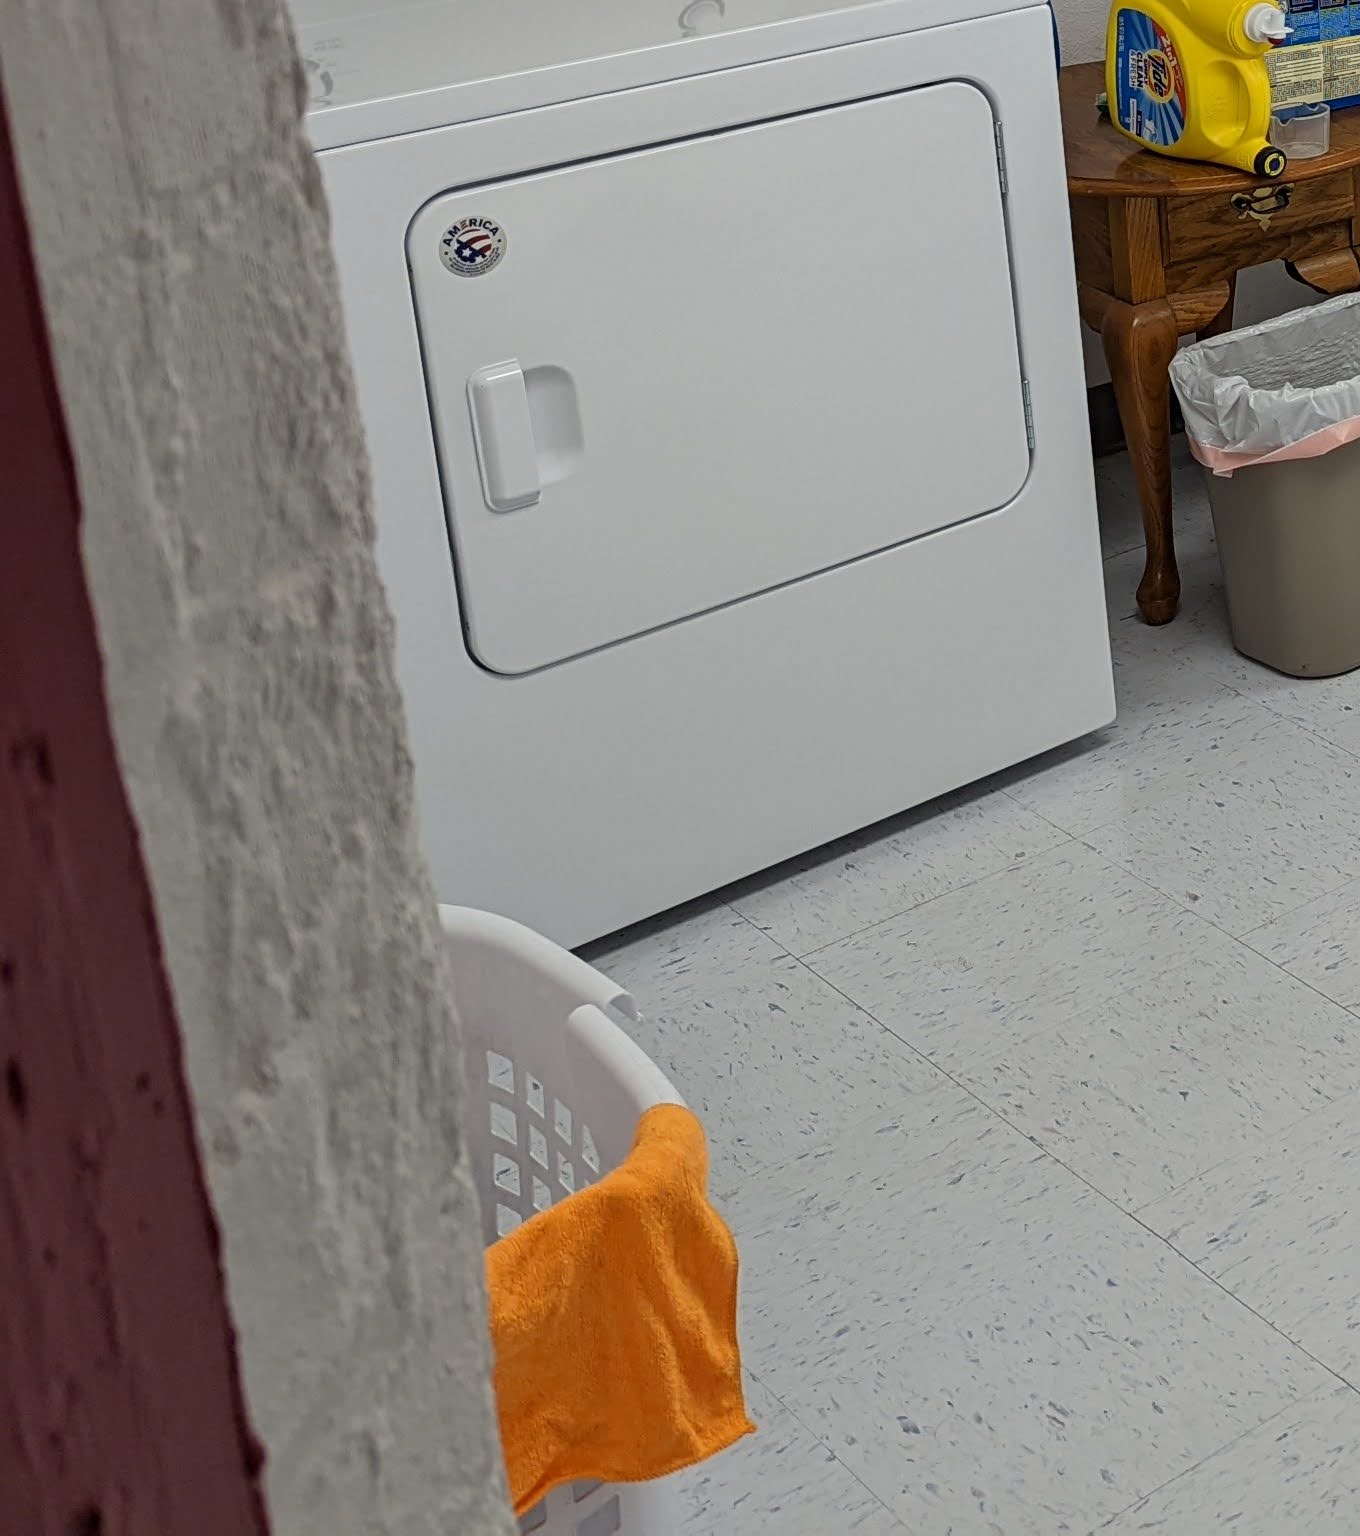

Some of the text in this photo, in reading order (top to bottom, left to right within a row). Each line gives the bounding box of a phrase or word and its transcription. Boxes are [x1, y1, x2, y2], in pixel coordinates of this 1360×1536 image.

[1136, 51, 1144, 89] CLEAN
[1148, 53, 1169, 98] Tide
[443, 218, 499, 247] AMERICA
